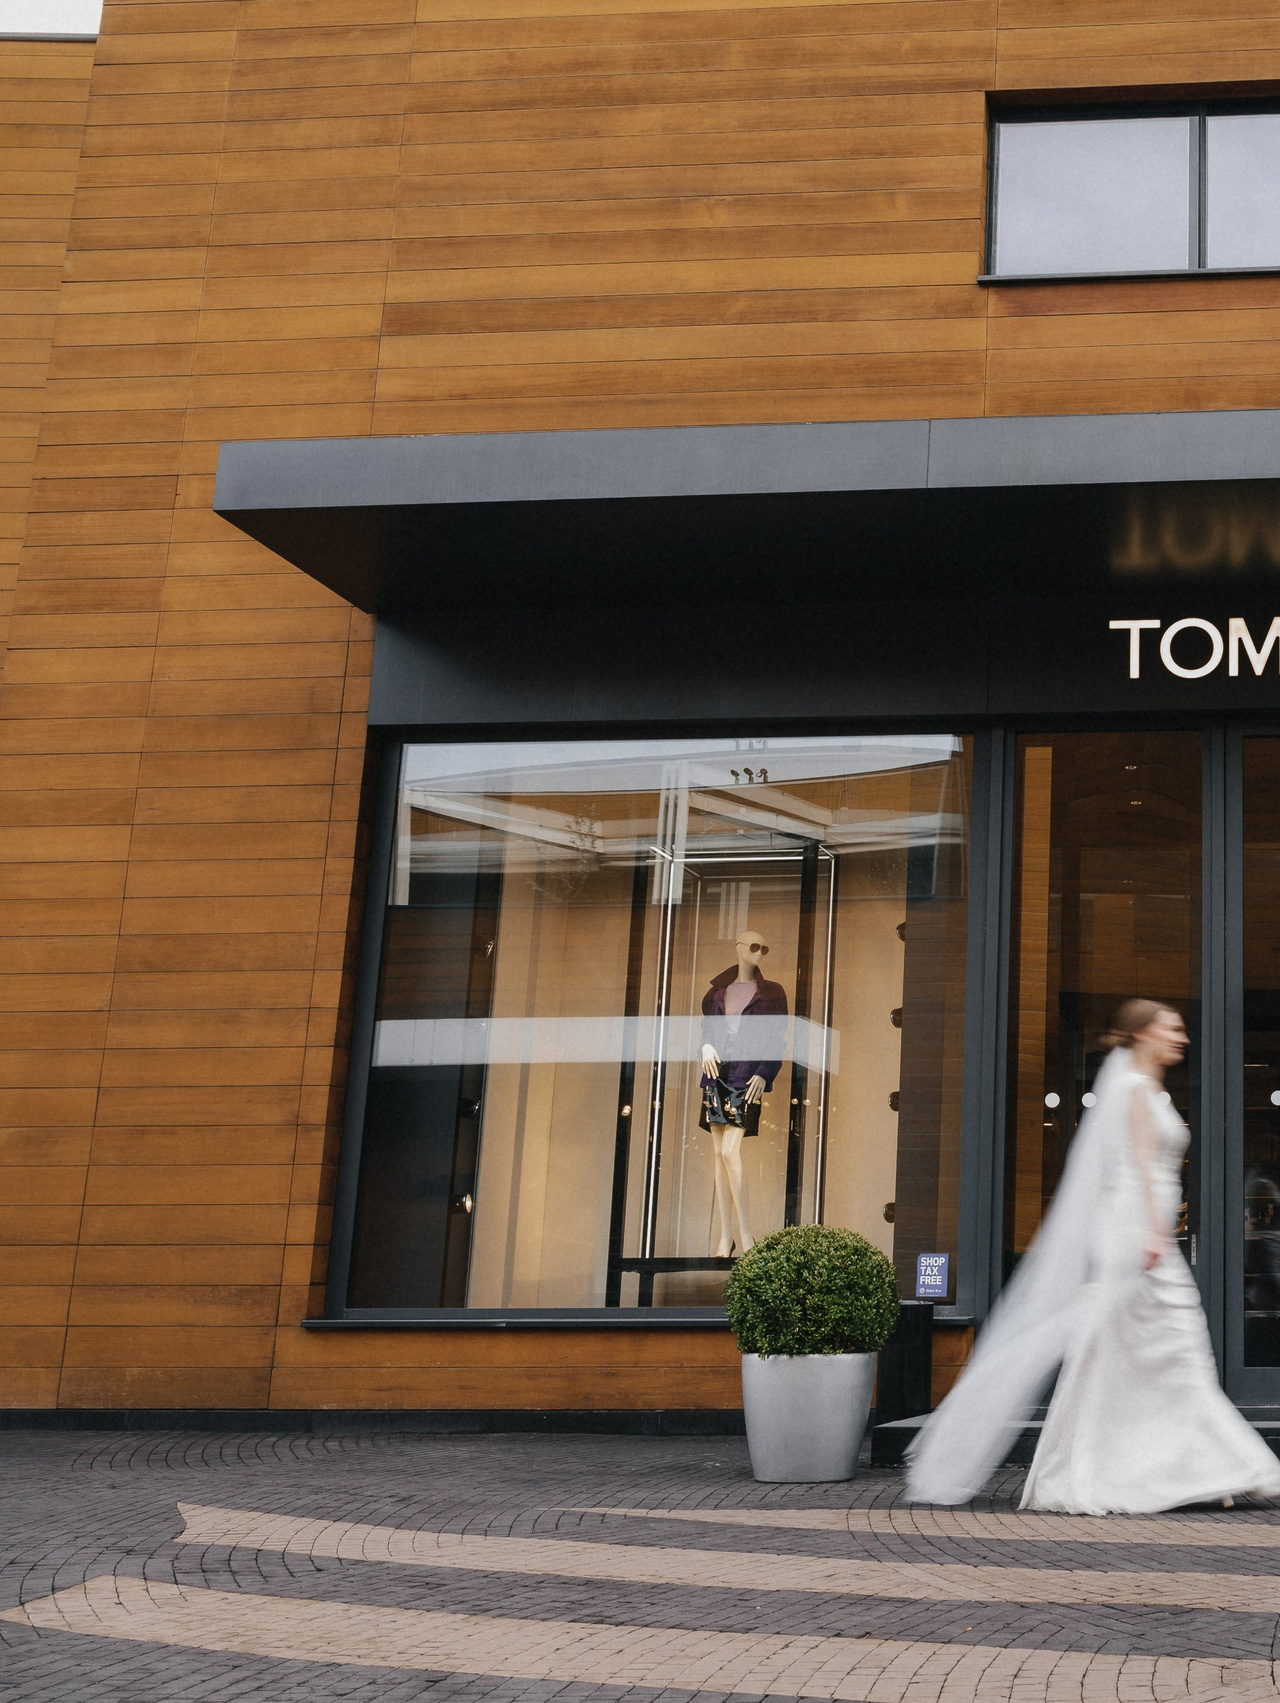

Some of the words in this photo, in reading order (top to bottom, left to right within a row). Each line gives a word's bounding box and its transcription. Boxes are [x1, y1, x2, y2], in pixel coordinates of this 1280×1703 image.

[920, 1257, 946, 1266] SHOP
[920, 1266, 939, 1275] TAX
[919, 1276, 942, 1285] FREE
